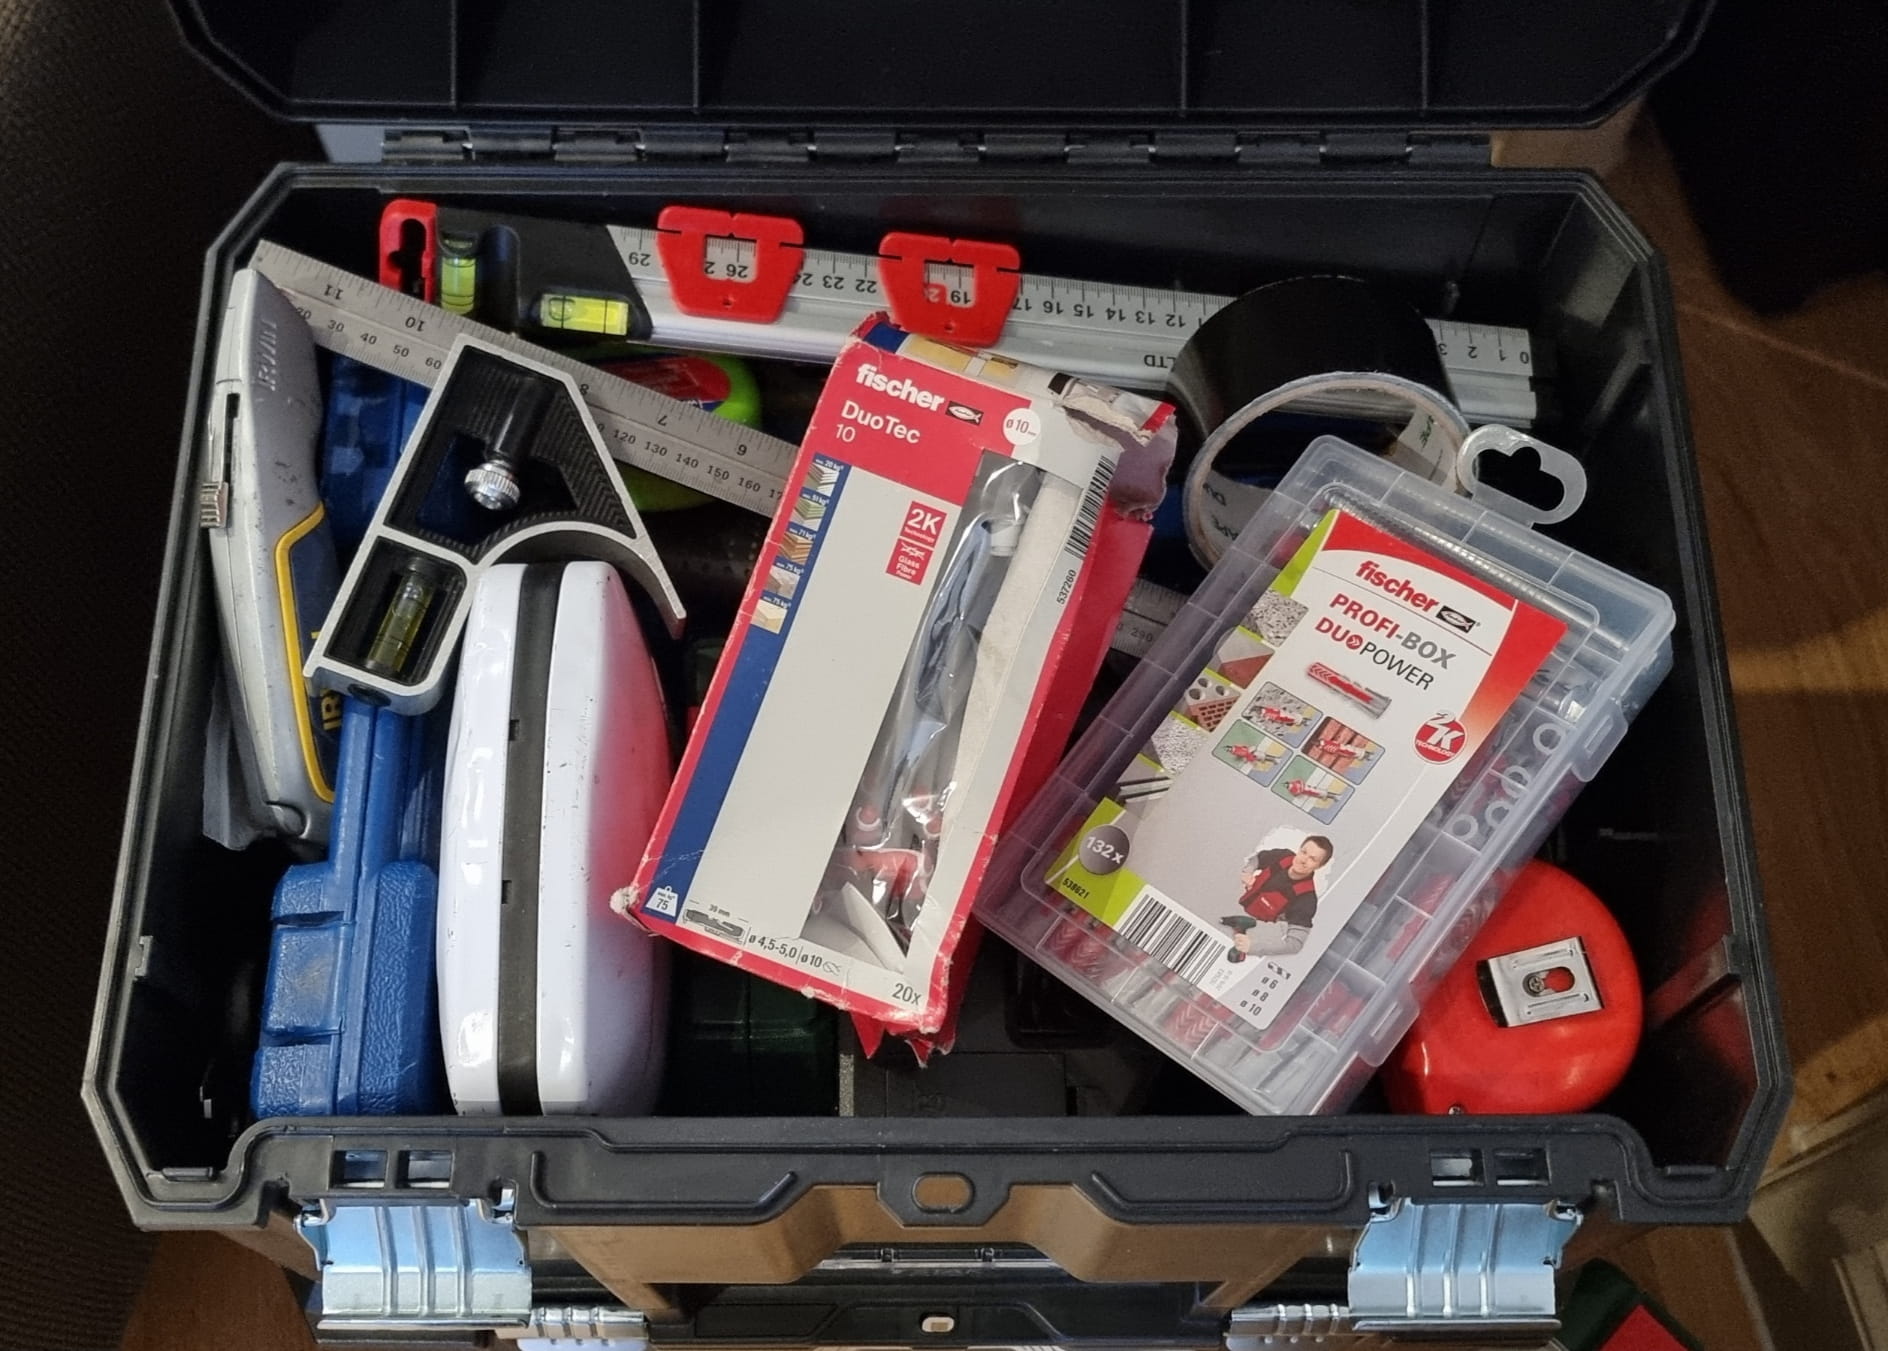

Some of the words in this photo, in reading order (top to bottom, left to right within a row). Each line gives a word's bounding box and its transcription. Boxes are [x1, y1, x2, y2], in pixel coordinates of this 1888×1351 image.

[628, 252, 652, 268] 29
[726, 264, 748, 278] 26
[822, 275, 844, 290] 23
[855, 278, 878, 294] 22
[324, 284, 344, 300] 11
[950, 290, 971, 305] 19
[1012, 298, 1032, 312] 17
[1043, 300, 1064, 314] 16
[1074, 304, 1095, 318] 15
[1106, 307, 1126, 322] 14
[1135, 310, 1156, 325] 13
[1165, 312, 1186, 328] 12
[1468, 346, 1478, 359] 2
[404, 316, 426, 332] 10
[580, 382, 590, 396] 8
[658, 416, 668, 426] 7
[736, 443, 748, 456] 6
[855, 362, 944, 412] fischer
[328, 319, 344, 333] 30
[360, 332, 378, 345] 40
[392, 344, 410, 358] 50
[425, 356, 442, 370] 60
[613, 428, 636, 445] 120
[644, 440, 668, 456] 130
[676, 452, 700, 469] 140
[706, 464, 730, 480] 150
[738, 476, 762, 492] 160
[840, 399, 920, 444] DuoTec
[834, 423, 856, 443] 10
[906, 508, 942, 535] 2K
[1056, 568, 1077, 605] 537260
[1355, 560, 1440, 613] fischer
[1330, 592, 1456, 670] PROFI-BOX
[1086, 836, 1124, 864] 132x
[1062, 876, 1090, 900] 538621
[656, 897, 669, 911] 75
[892, 982, 922, 1006] 20x
